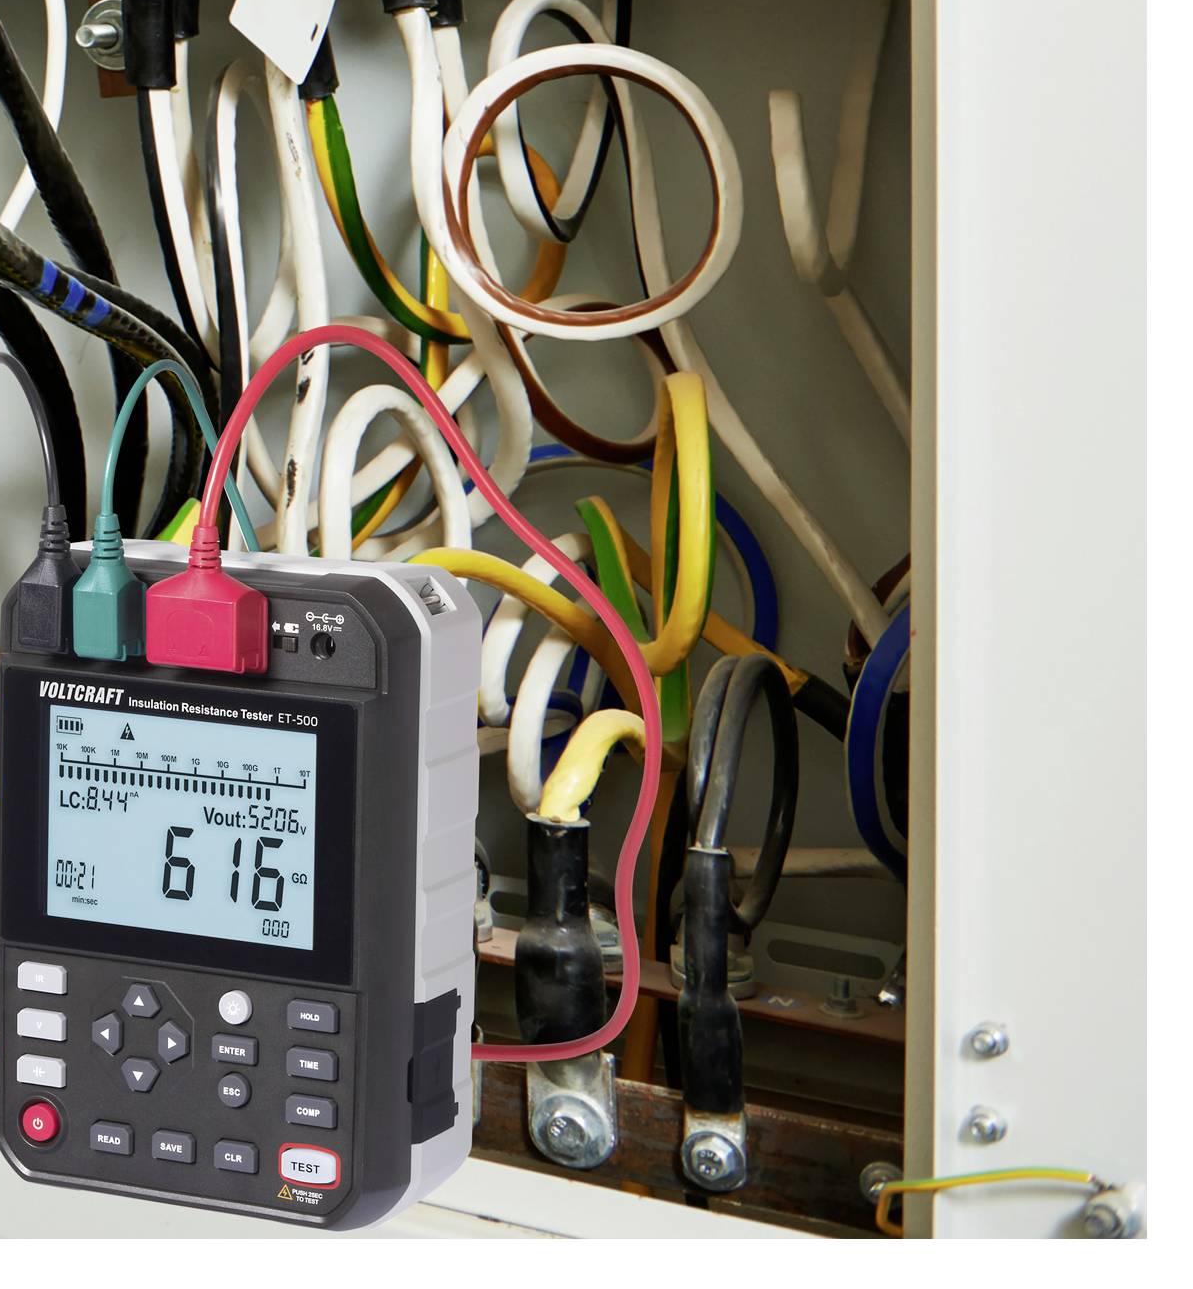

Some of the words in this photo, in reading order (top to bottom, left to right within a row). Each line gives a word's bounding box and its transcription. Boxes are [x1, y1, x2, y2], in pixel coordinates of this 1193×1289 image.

[311, 623, 333, 632] 16.8V
[39, 680, 124, 706] VOLTCRAFT
[128, 697, 179, 712] Insulation
[181, 703, 238, 719] Resistance
[241, 709, 273, 722] Tester
[278, 713, 318, 727] ET-500
[80, 746, 95, 754] 100K
[135, 752, 148, 760] 10M
[160, 755, 176, 763] 100M
[216, 761, 229, 769] 10G
[242, 764, 258, 772] 100G
[299, 770, 310, 778] 10T
[56, 860, 94, 889] 00:21
[72, 896, 97, 905] min:sec
[35, 973, 44, 983] IR
[301, 1013, 319, 1021] HOLD
[36, 1021, 43, 1030] V
[219, 1046, 245, 1056] ENTER
[300, 1060, 318, 1069] TIME
[224, 1087, 240, 1096] ESC
[297, 1107, 320, 1117] COMP
[98, 1135, 120, 1144] READ
[160, 1143, 182, 1153] SAVE
[225, 1153, 241, 1162] CLR
[291, 1162, 319, 1173] TEST
[292, 1189, 307, 1197] PUSH
[308, 1192, 323, 1200] 2SEC
